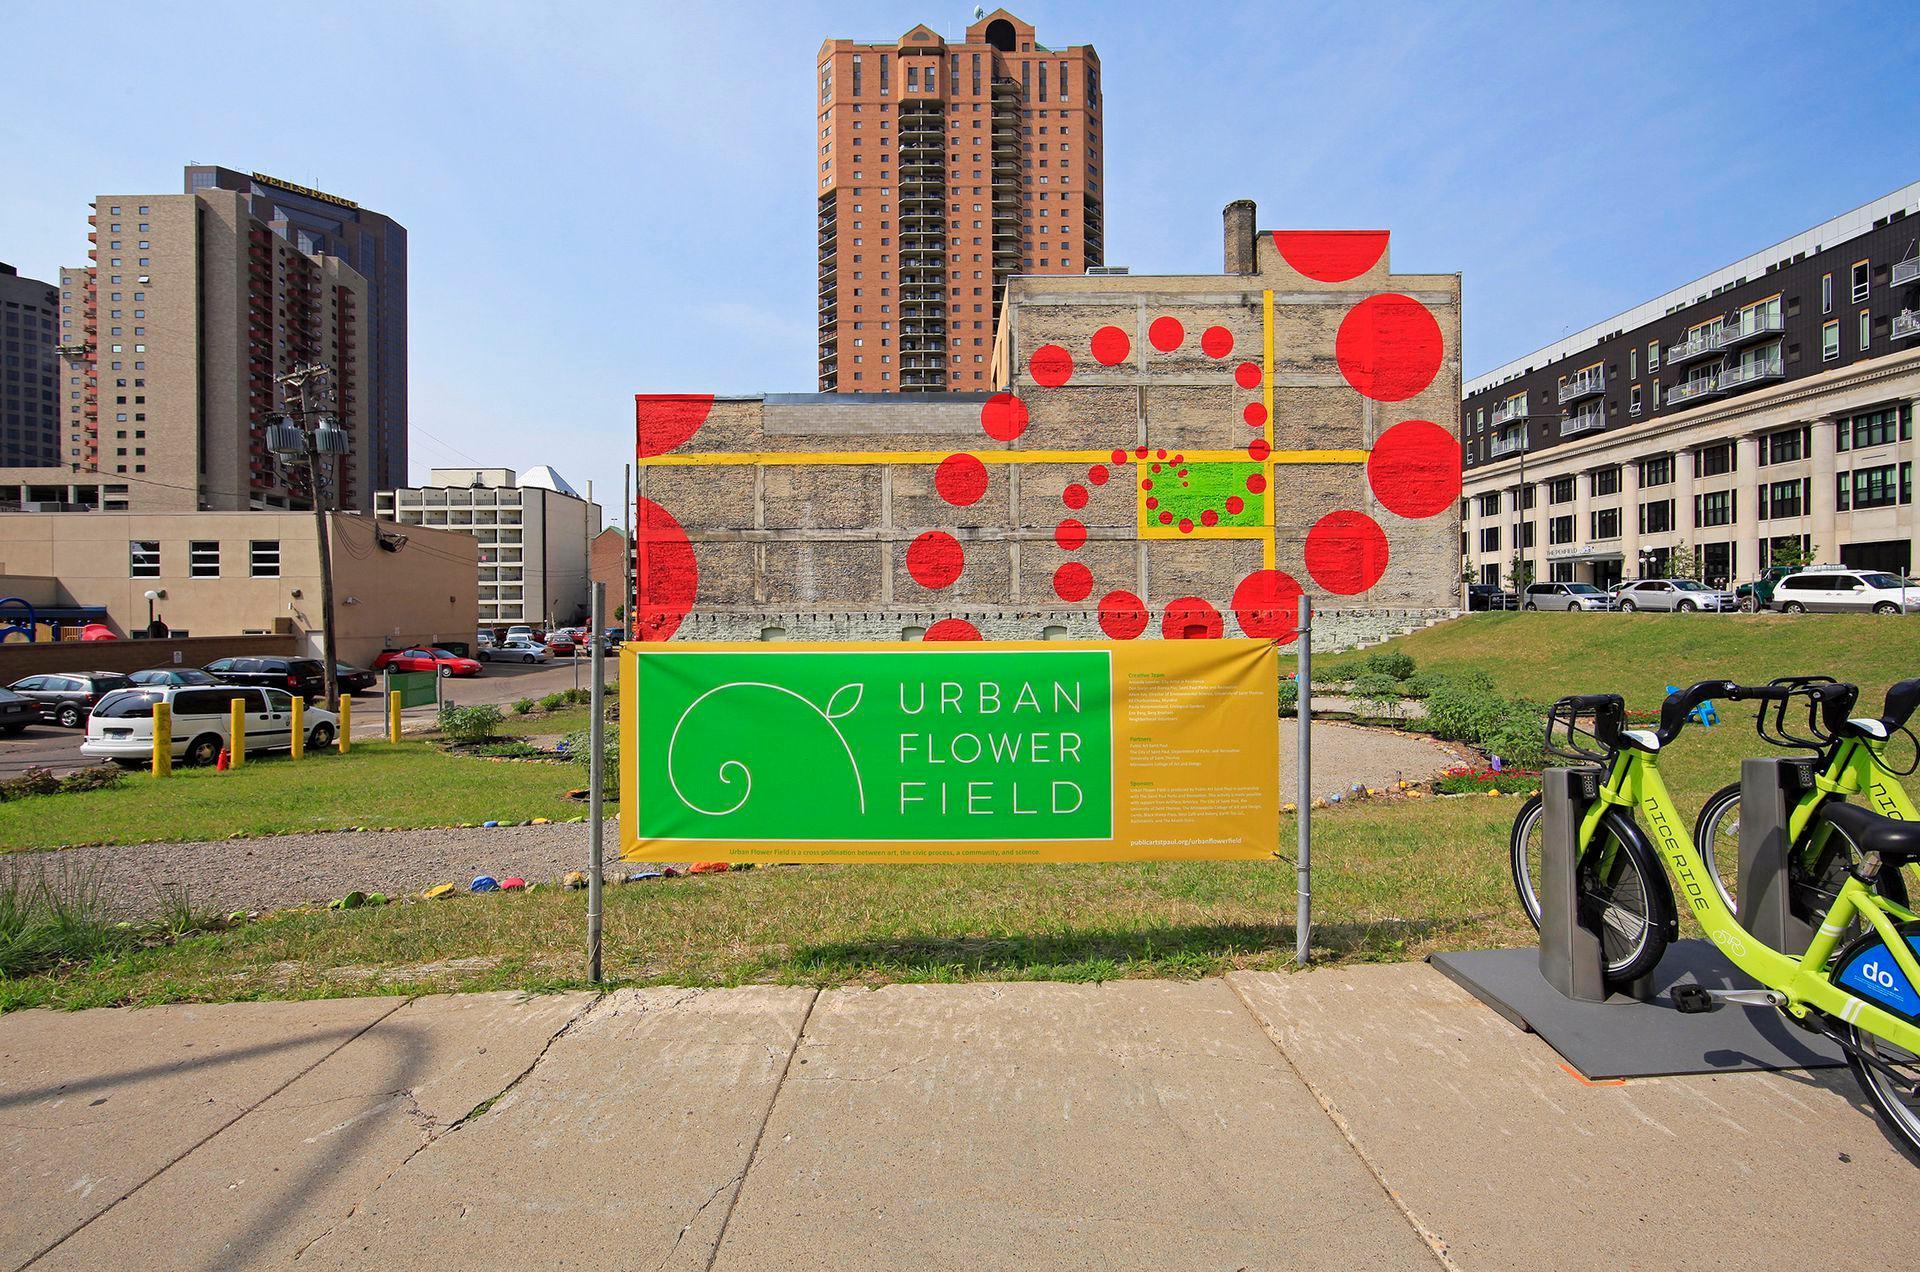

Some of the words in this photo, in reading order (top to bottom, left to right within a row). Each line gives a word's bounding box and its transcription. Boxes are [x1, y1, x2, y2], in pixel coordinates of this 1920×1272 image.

[254, 172, 308, 195] WELLS
[310, 189, 359, 209] FARGO
[900, 681, 1080, 714] URBAN
[900, 733, 1081, 763] FLOWER
[901, 781, 1083, 814] FIELD
[962, 849, 1000, 857] community,
[1130, 837, 1242, 847] publicartstpaul.org/urbanflowerfield
